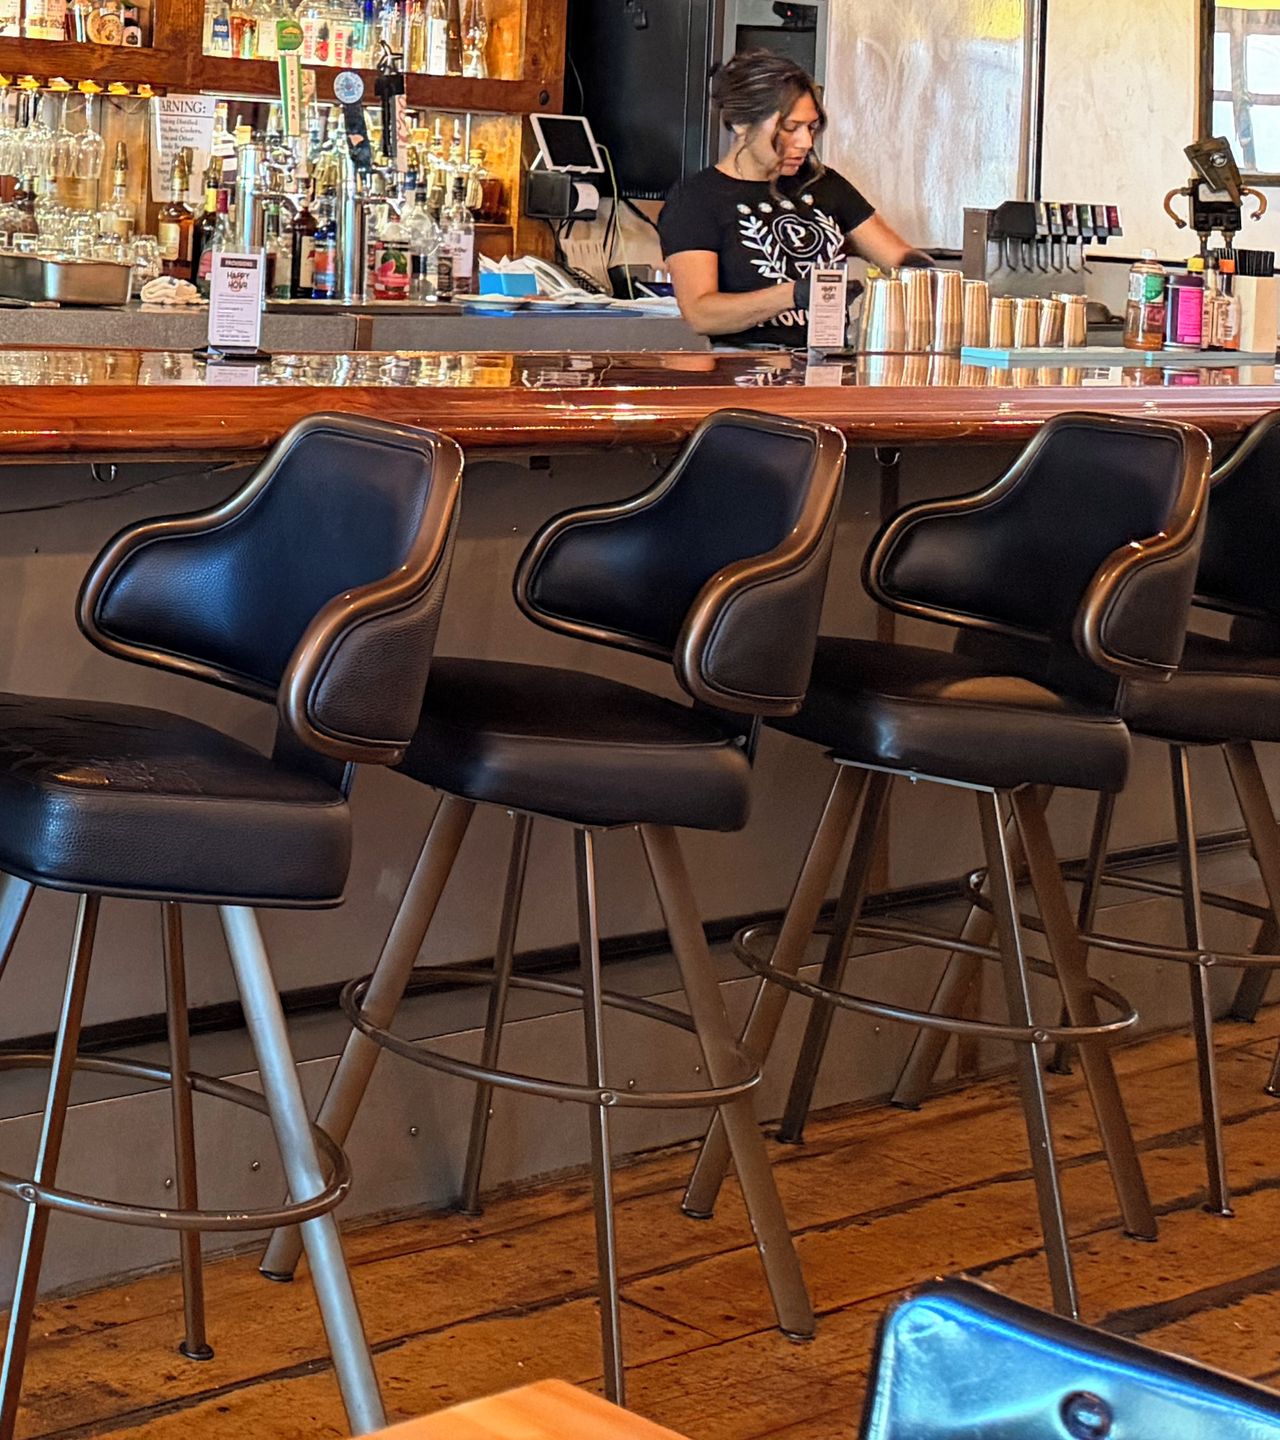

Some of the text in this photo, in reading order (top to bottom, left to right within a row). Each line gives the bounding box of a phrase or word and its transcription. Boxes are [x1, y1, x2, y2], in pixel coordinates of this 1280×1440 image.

[159, 100, 207, 114] ARNING:
[784, 223, 806, 247] P
[226, 270, 250, 280] HAPPY
[227, 281, 248, 290] HOUR
